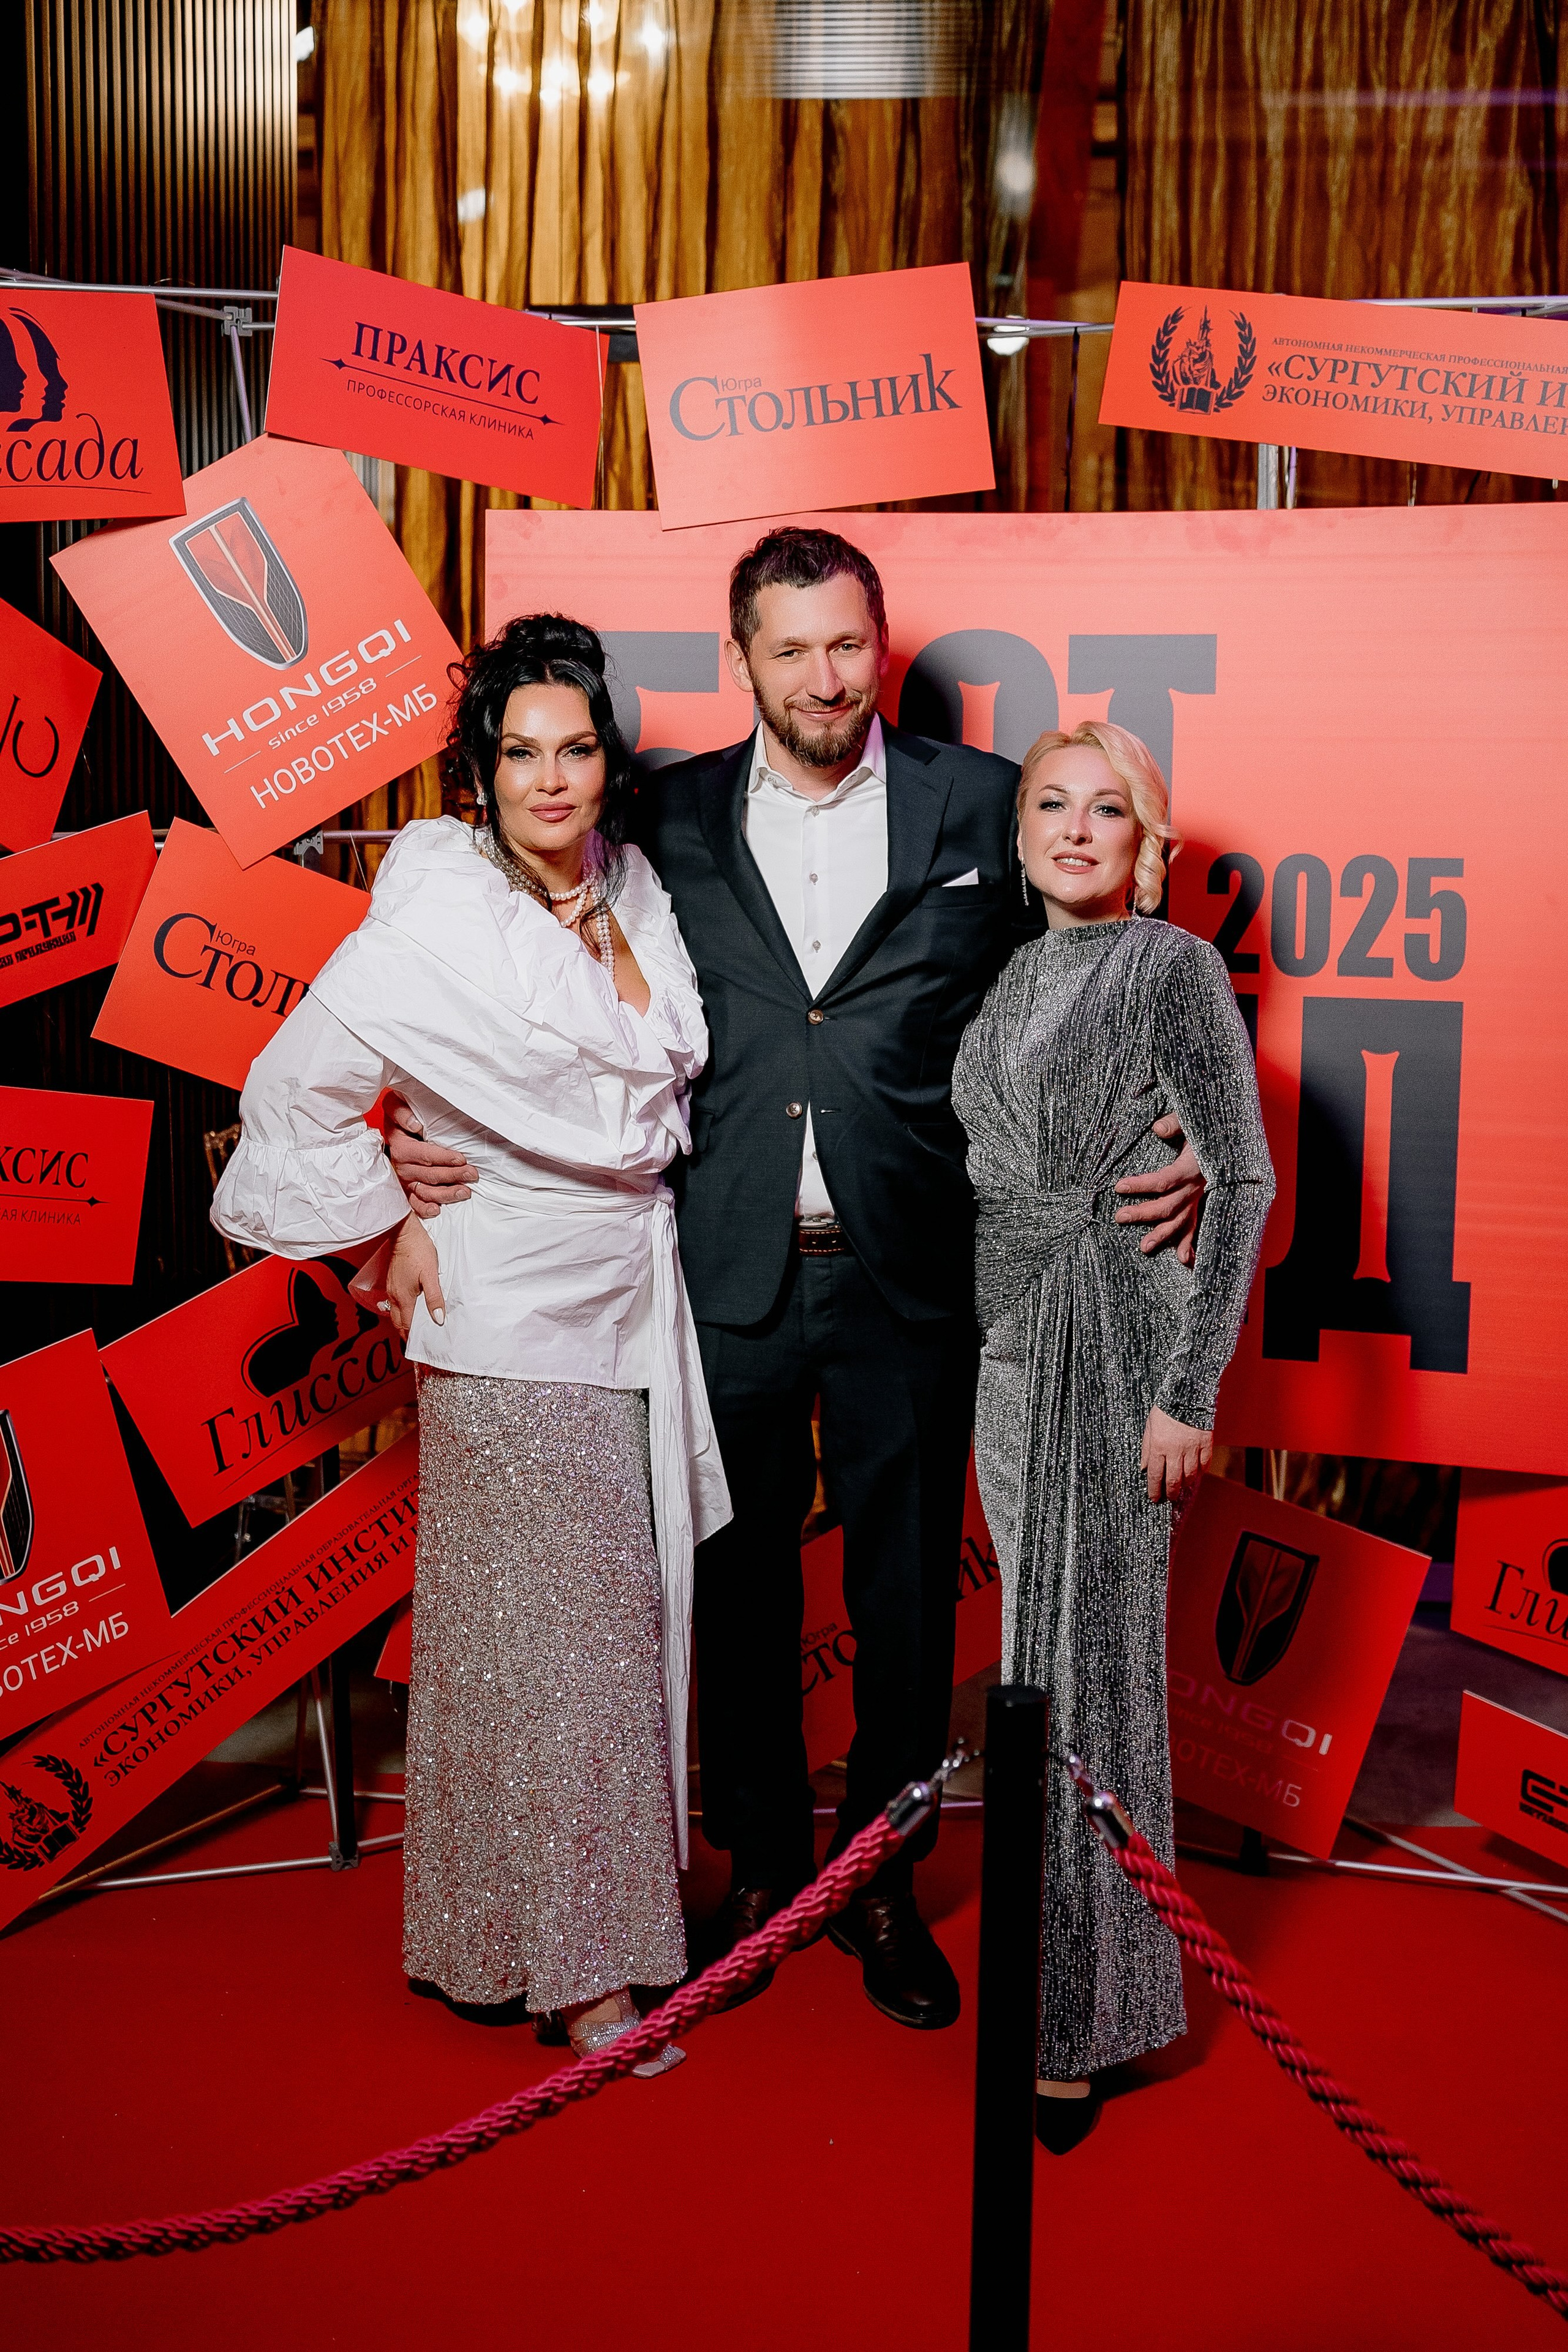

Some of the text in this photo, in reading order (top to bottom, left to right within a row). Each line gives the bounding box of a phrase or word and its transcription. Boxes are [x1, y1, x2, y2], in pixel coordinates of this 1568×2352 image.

[352, 321, 541, 405] ПРАКСИС
[721, 376, 762, 393] Югра
[1267, 354, 1529, 404] «СУРГУТСКИЙ
[1272, 337, 1568, 375] АВТОНОМНАЯ НЕКОММЕРЧЕСКАЯ ПРОФЕССИОНАЛЬНАЯ
[347, 379, 534, 440] ПРОФЕССОРСКАЯ КЛИНИКА
[1262, 384, 1433, 424] ЭКОНОМИКИ,
[0, 413, 144, 482] сада
[202, 619, 412, 757] HONGQI
[268, 677, 377, 750] since 1958
[249, 683, 437, 809] НОВОТЕХ-МБ
[215, 929, 256, 956] Югра
[1207, 853, 1468, 982] 2025
[21, 1210, 81, 1226] КЛИНИКА
[201, 1337, 407, 1477] Глисса
[0, 1611, 129, 1698] ОТЕХ-МБ
[24, 1600, 80, 1637] 1958
[78, 1695, 140, 1750] АВТОНОМНАЯ
[140, 1628, 222, 1697] НЕКОММЕРЧЕСКАЯ
[222, 1553, 316, 1630] ПРОФЕССИОНАЛЬНАЯ
[316, 1490, 397, 1556] ОБРАЗОВАТЕЛЬНАЯ
[93, 1586, 304, 1767] «СУРГУТСКИЙ
[104, 1534, 410, 1787] ЭКОНОМИКИ, УПРАВЛЕНИЯ И
[1166, 1670, 1333, 1755] ONGQI
[1170, 1733, 1302, 1807] ОТЕХ-МБ
